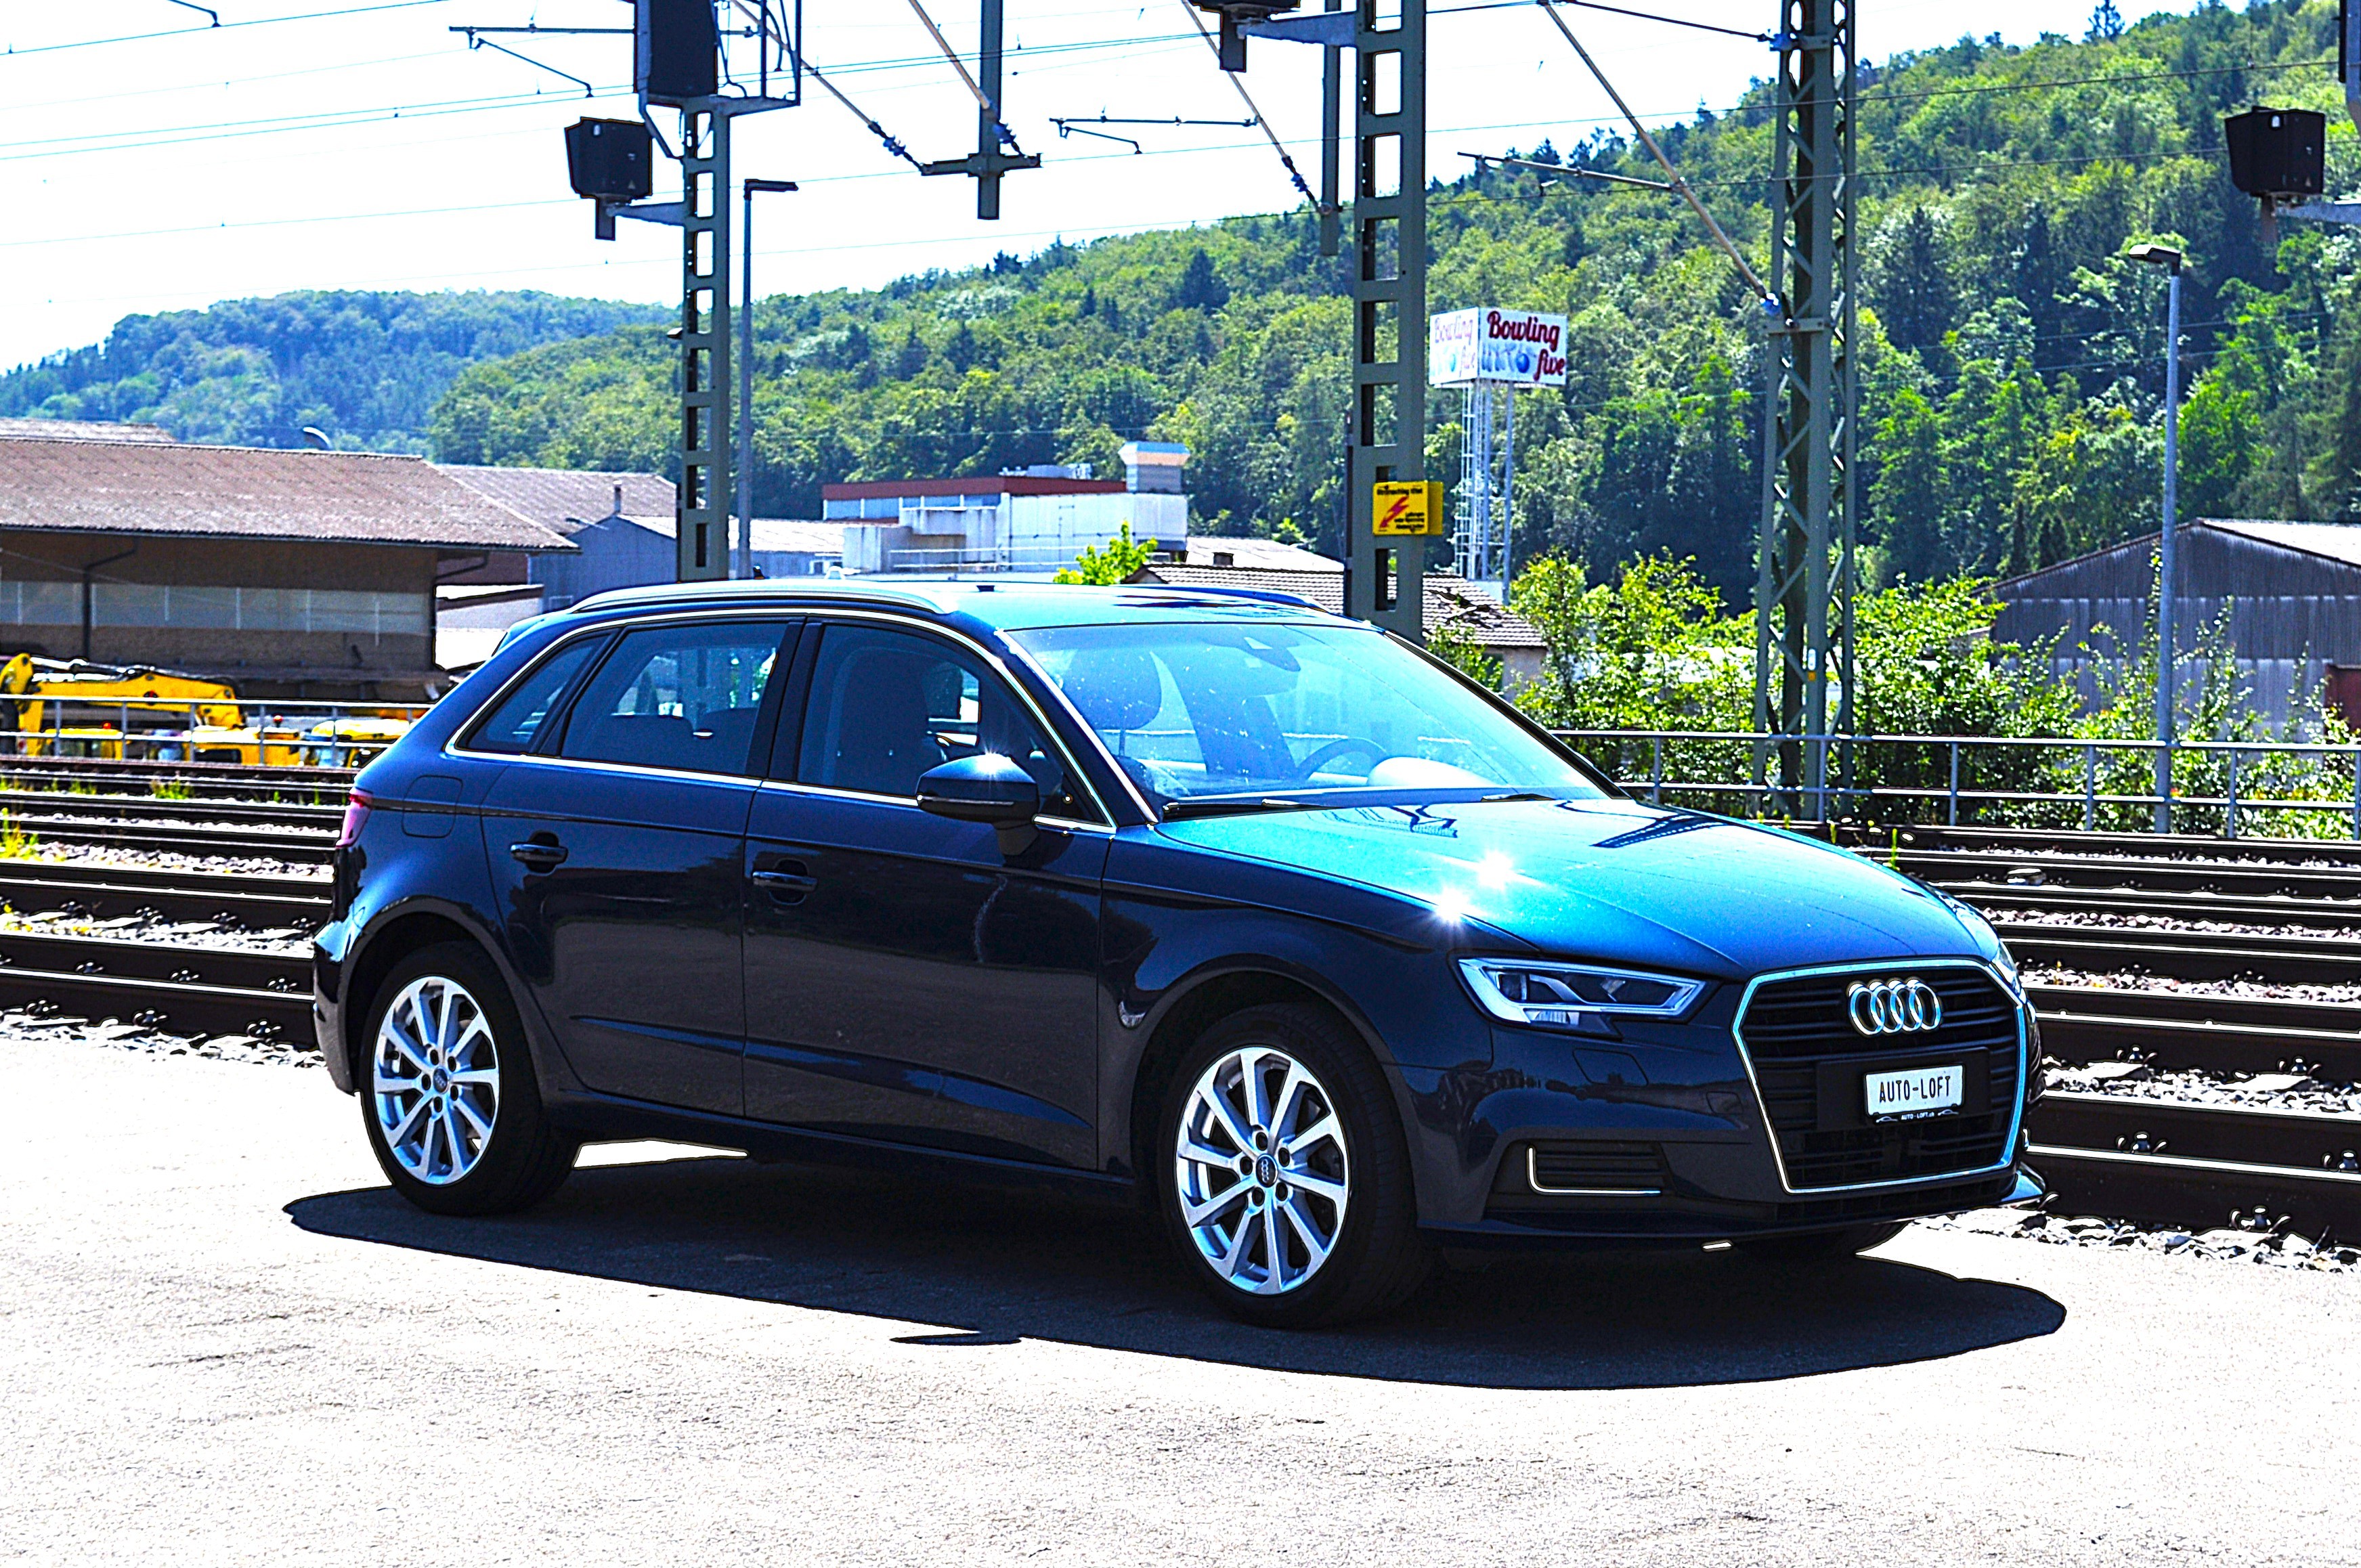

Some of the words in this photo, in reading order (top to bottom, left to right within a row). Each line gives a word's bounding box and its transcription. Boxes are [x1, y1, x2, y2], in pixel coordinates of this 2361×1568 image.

[1487, 310, 1561, 352] Bowling
[1533, 349, 1565, 381] five
[1879, 1076, 1951, 1104] AUTO-LOFT
